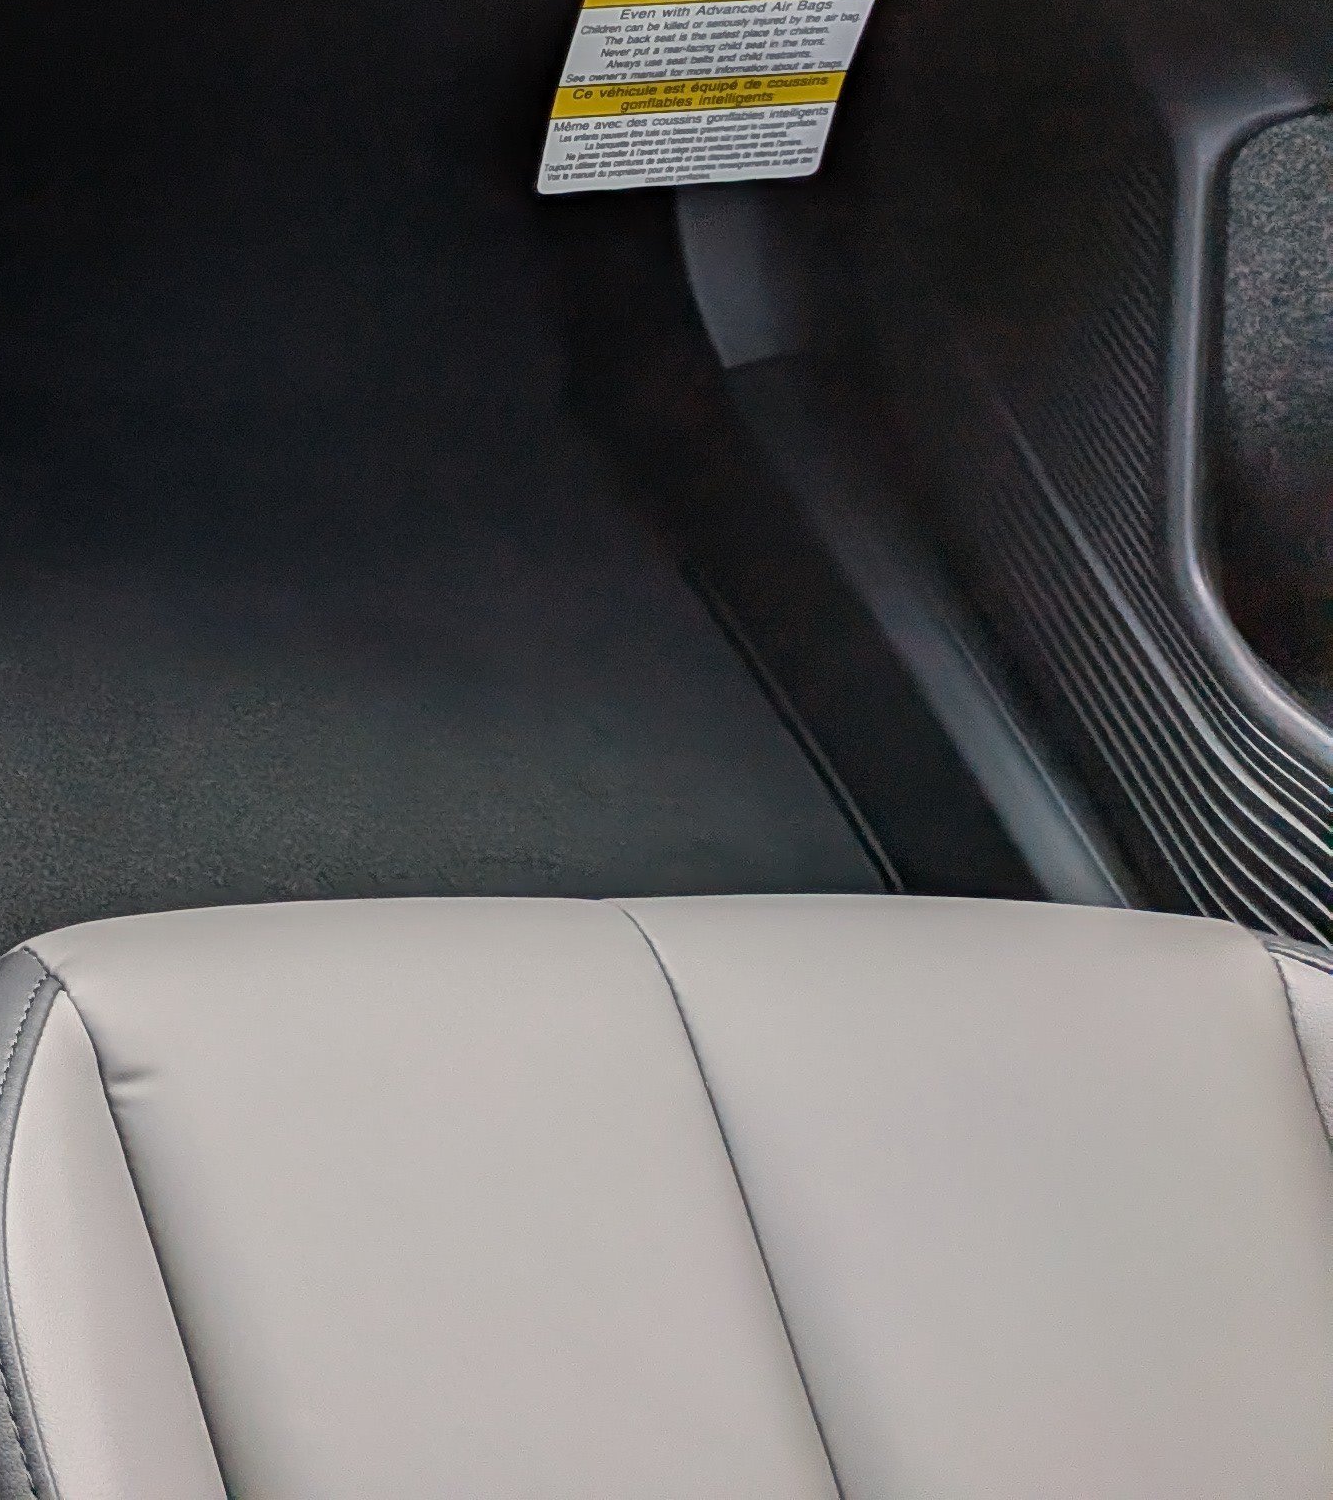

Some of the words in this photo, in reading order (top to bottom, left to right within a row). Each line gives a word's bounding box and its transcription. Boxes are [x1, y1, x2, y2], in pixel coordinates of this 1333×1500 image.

[619, 8, 656, 20] Even
[662, 6, 690, 17] with
[695, 2, 767, 15] Advanced
[770, 1, 792, 11] Air
[796, 0, 833, 12] Bags
[605, 35, 623, 45] The
[626, 34, 651, 44] back
[653, 33, 676, 43] seat
[690, 31, 707, 40] the
[741, 28, 770, 39] place
[773, 27, 787, 36] for
[572, 88, 593, 99] Ce
[662, 83, 685, 94] est
[690, 79, 738, 93] équipé
[743, 78, 762, 89] de
[766, 76, 828, 88] coussins
